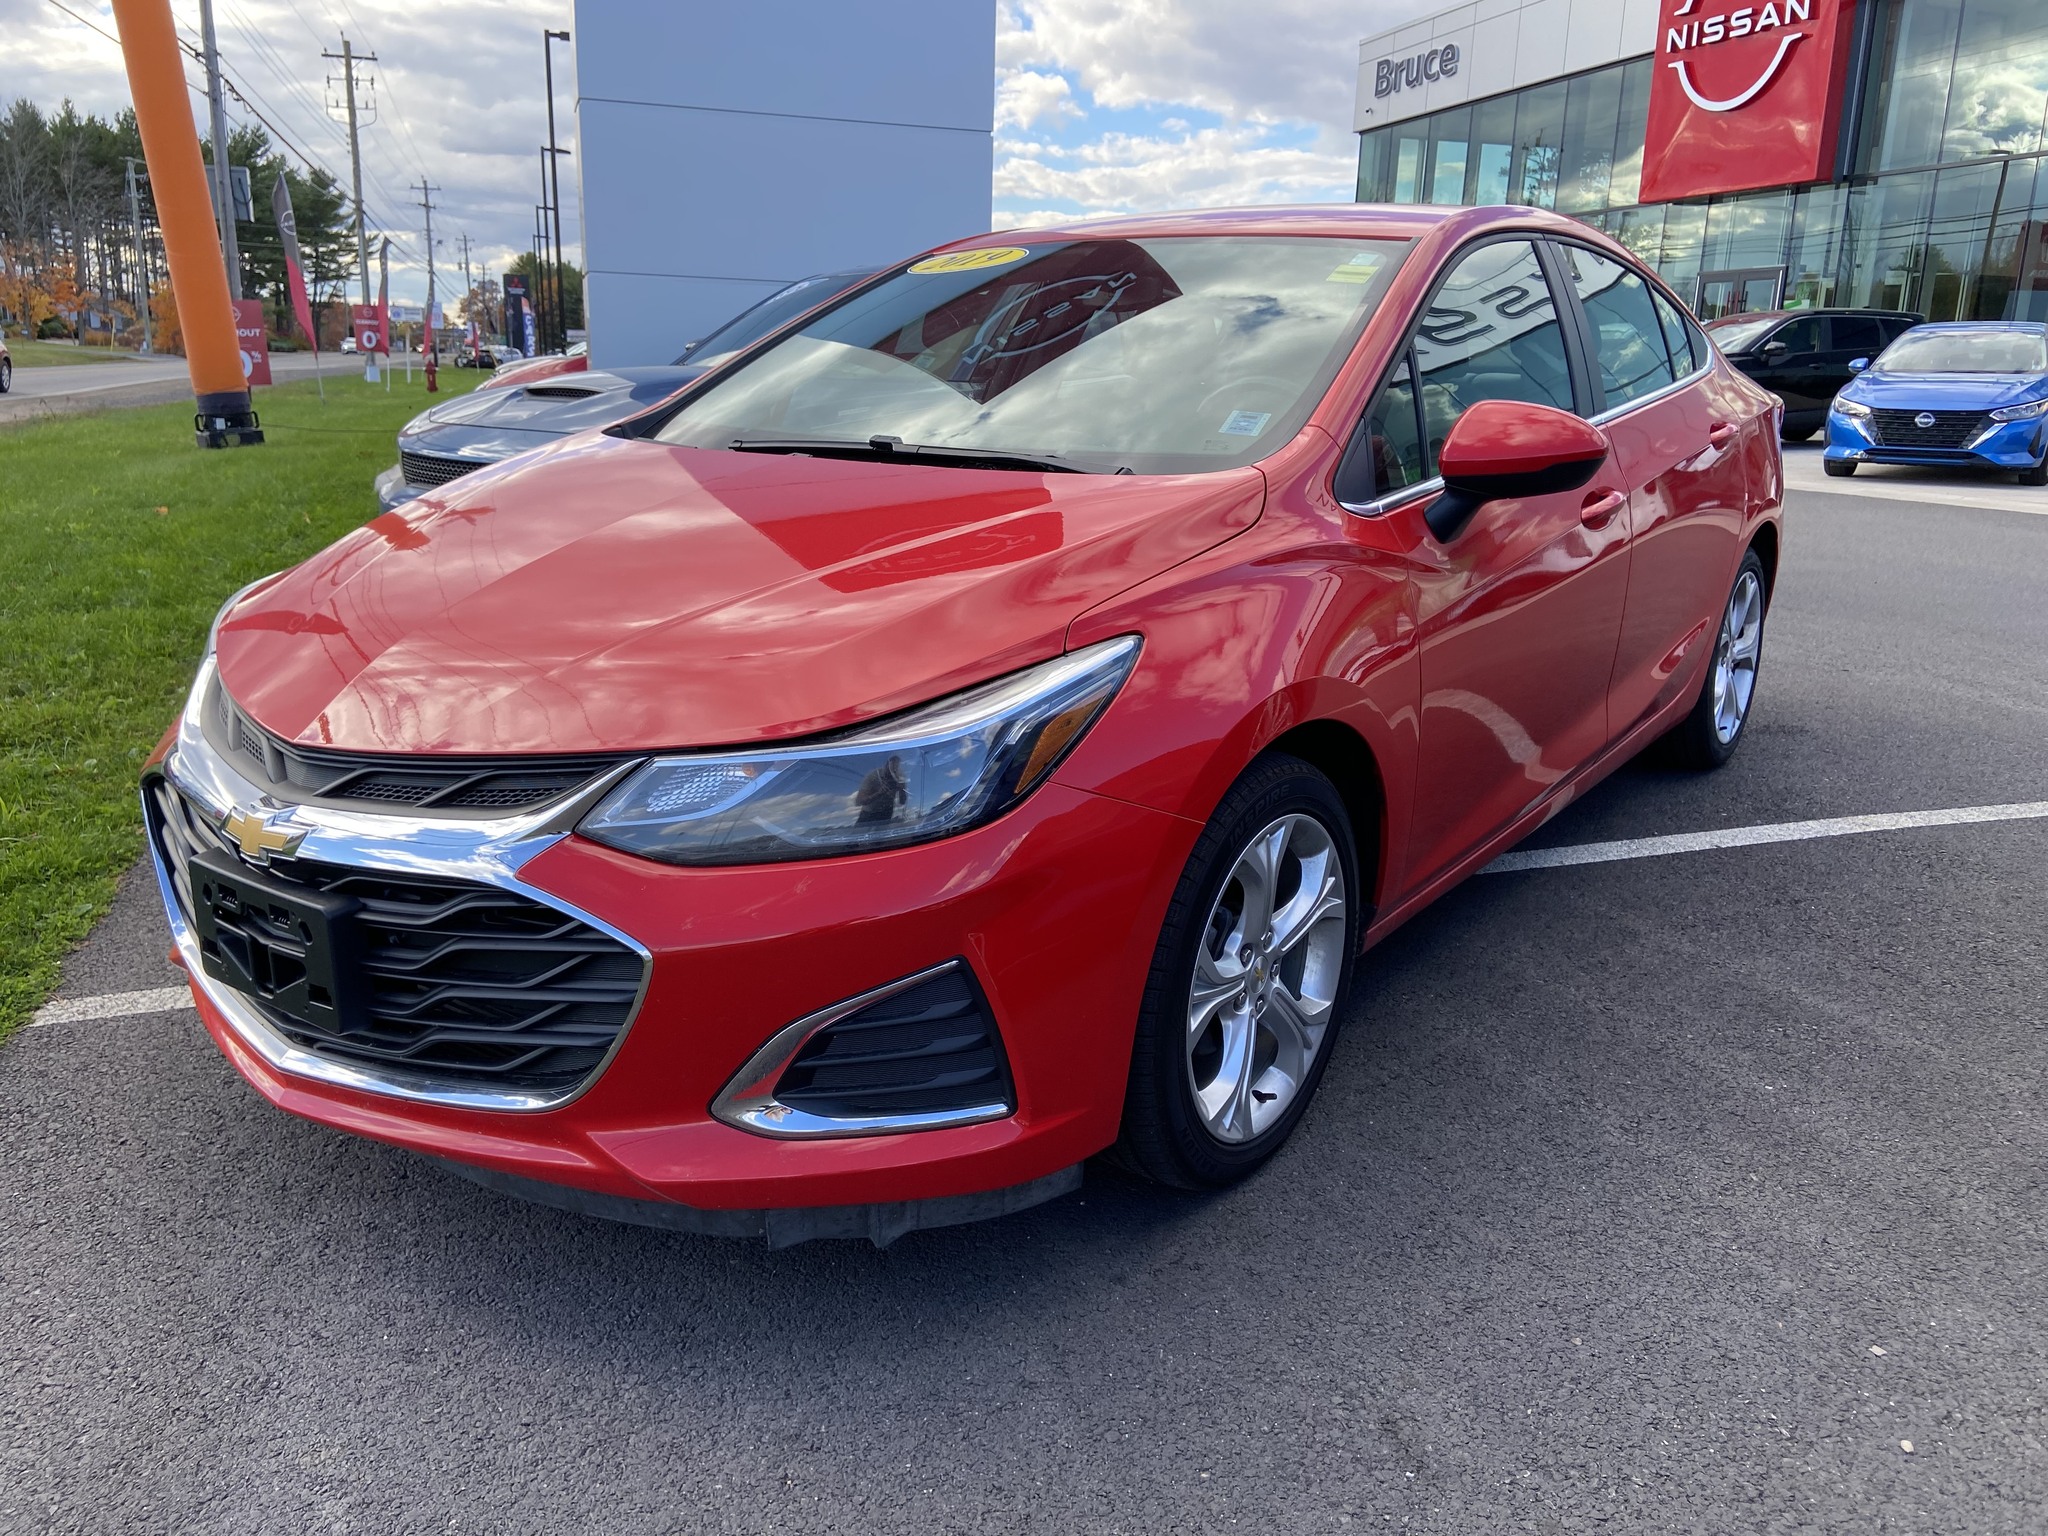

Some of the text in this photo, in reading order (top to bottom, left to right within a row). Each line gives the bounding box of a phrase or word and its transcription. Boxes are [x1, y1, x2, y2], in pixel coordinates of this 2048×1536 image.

[1666, 0, 1810, 53] NISSAN
[1374, 43, 1460, 98] Bruce
[919, 250, 1014, 271] 2019
[525, 315, 536, 357] CARS
[1230, 784, 1291, 846] INSPIRE
